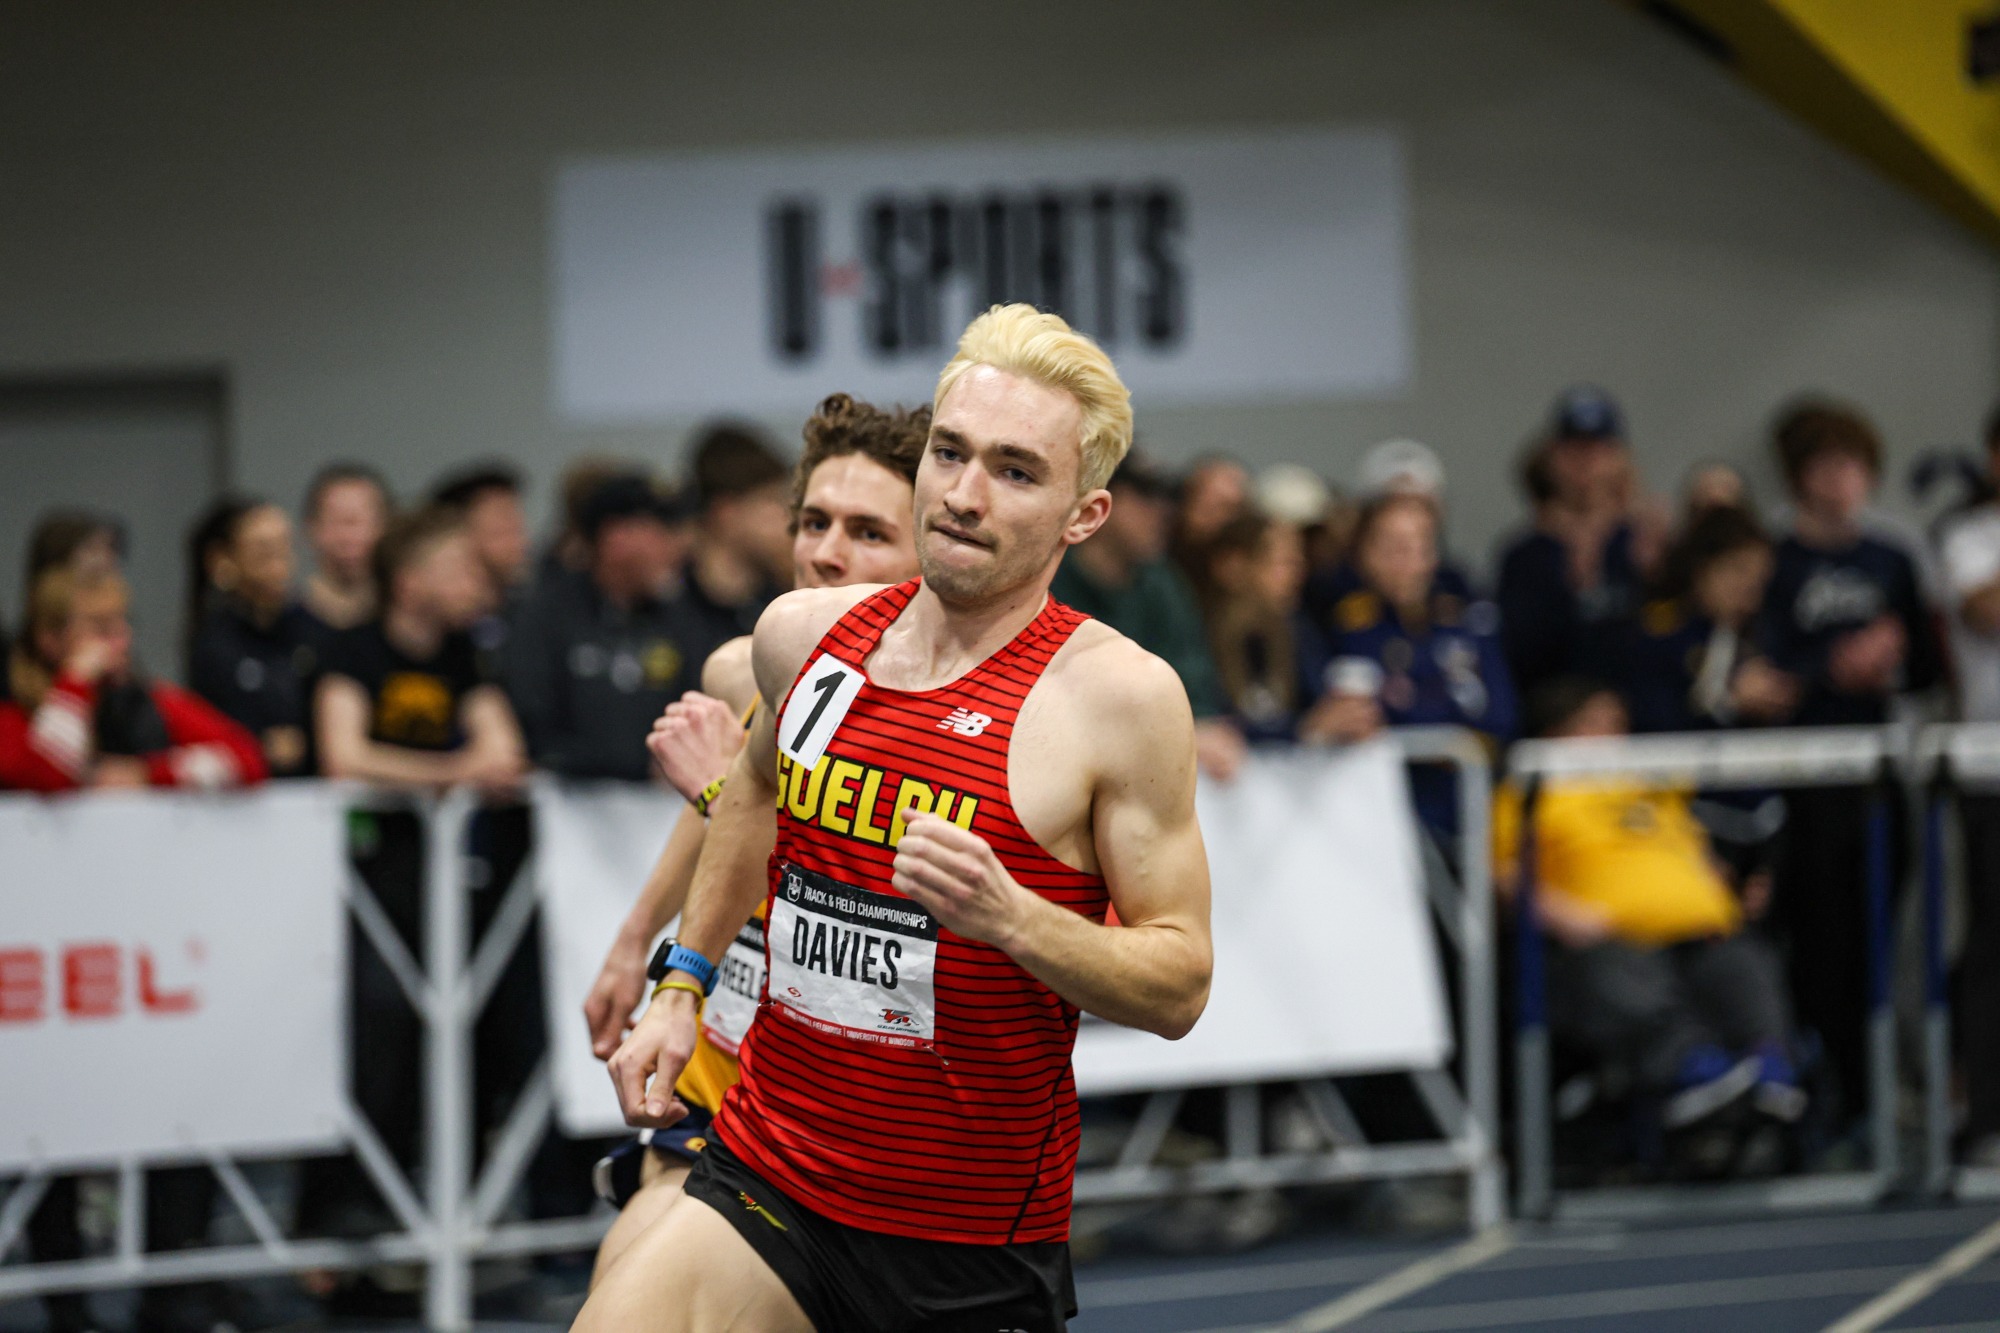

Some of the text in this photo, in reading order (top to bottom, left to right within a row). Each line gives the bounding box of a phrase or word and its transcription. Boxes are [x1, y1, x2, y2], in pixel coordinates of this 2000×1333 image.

[790, 670, 847, 754] 1
[804, 885, 827, 905] TRACK
[828, 894, 834, 908] &
[835, 896, 856, 914] FIELD
[857, 902, 928, 929] CHAMPIONSHIPS
[792, 915, 902, 990] DAVIES
[846, 1030, 879, 1043] UNIVERSITY
[880, 1034, 888, 1043] OF
[888, 1036, 915, 1047] WINDSOR
